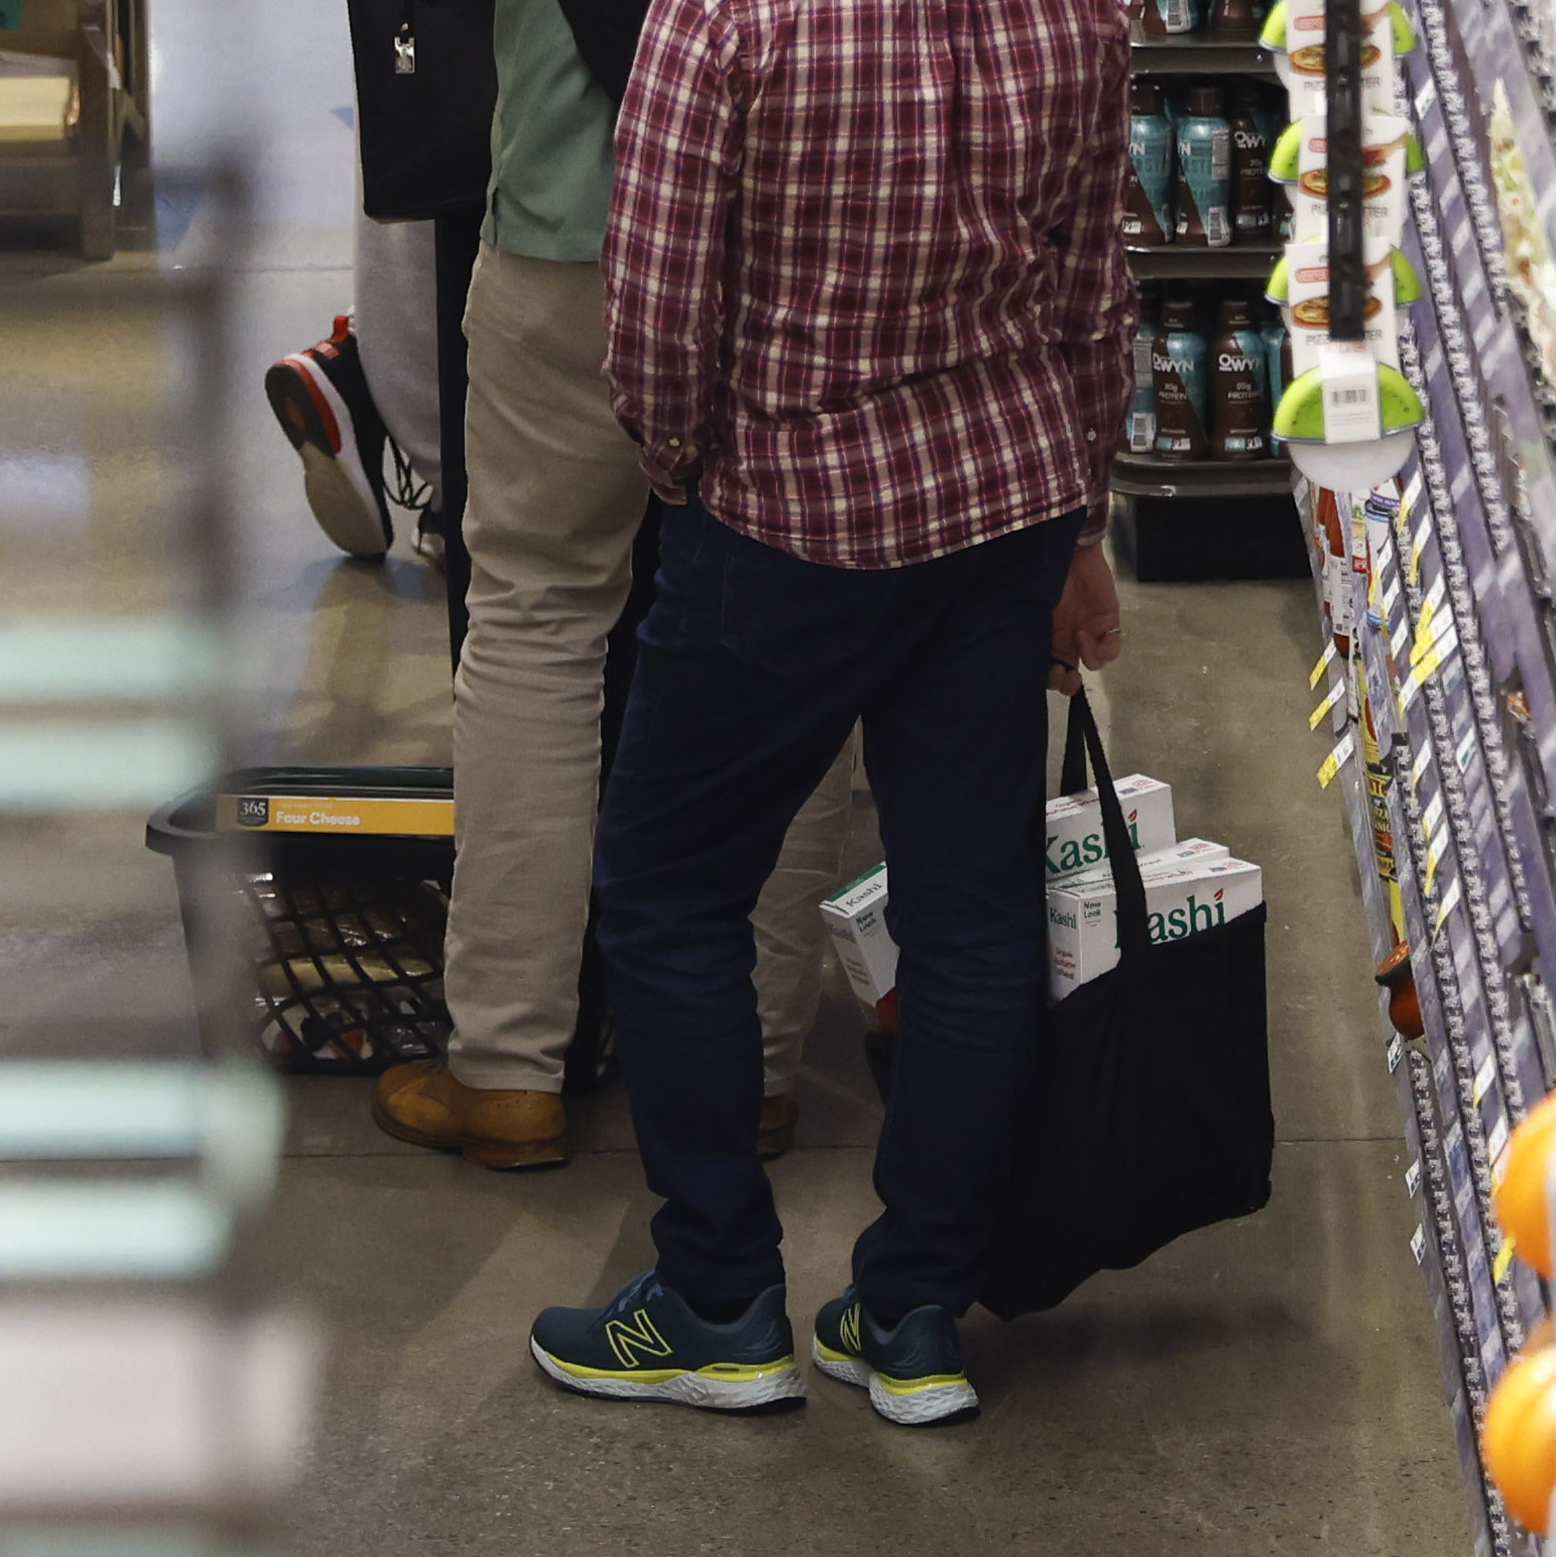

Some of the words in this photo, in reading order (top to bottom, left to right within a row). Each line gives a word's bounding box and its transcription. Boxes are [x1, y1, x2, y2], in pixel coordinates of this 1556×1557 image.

[239, 801, 267, 817] 365
[275, 810, 308, 824] Four
[309, 811, 361, 826] Cheese
[845, 882, 882, 908] Kashi
[1083, 901, 1102, 910] New
[1049, 907, 1077, 930] Kashi
[1083, 910, 1102, 919] Look
